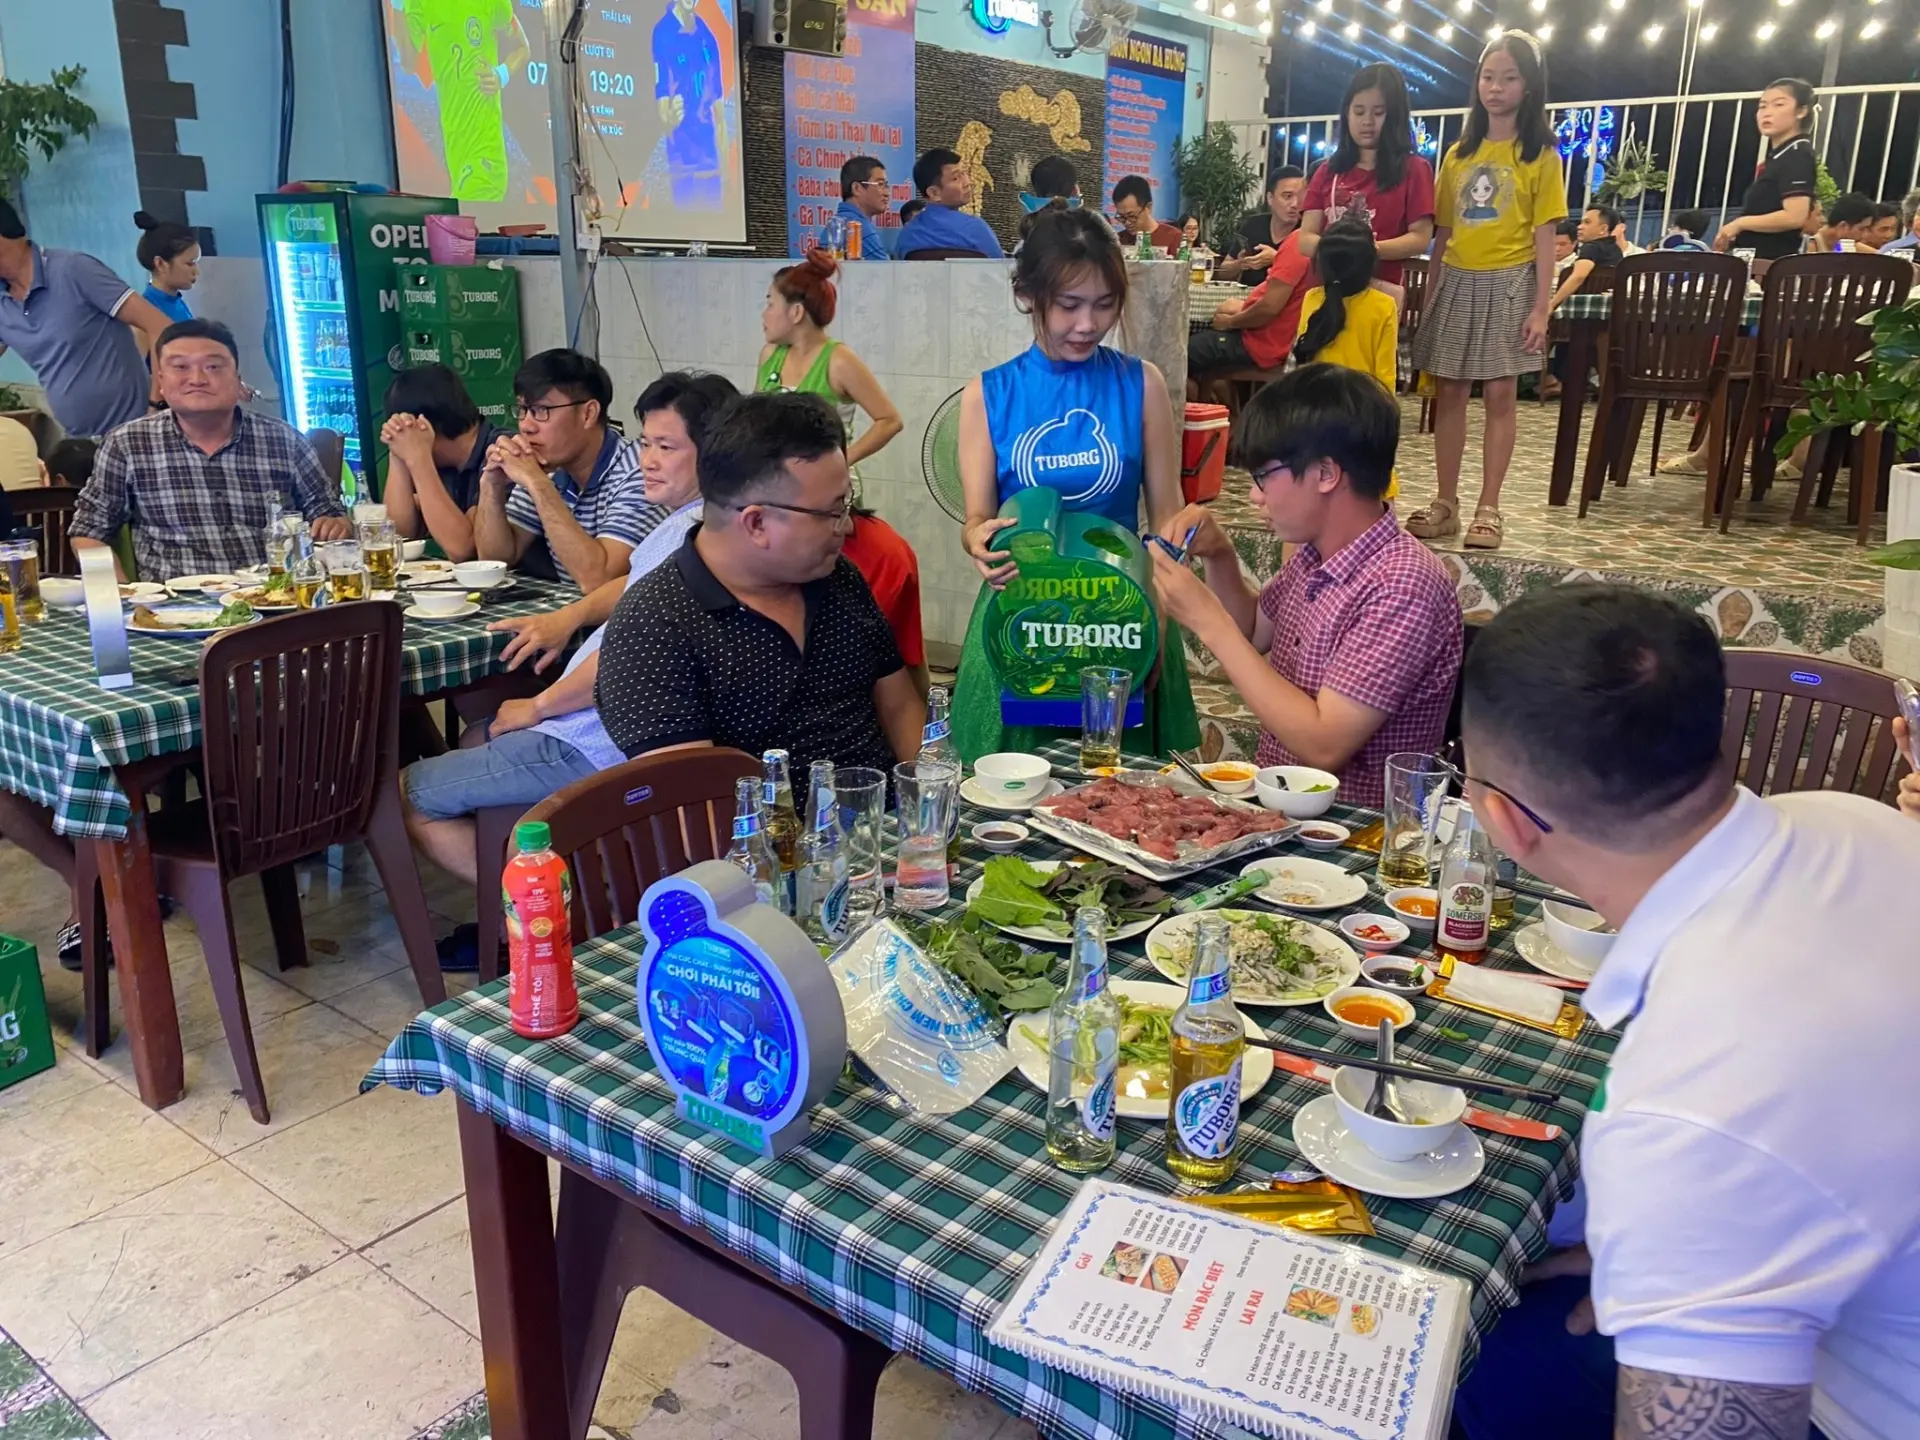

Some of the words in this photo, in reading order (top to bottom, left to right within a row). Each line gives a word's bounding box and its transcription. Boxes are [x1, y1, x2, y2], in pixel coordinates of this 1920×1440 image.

[527, 61, 548, 85] 07
[590, 70, 634, 96] 19:20
[370, 224, 429, 249] OPE
[404, 289, 437, 305] TUBORG
[462, 291, 499, 303] TUBORG
[409, 348, 440, 362] TUBORG
[1035, 449, 1100, 472] TUBORG
[1022, 621, 1141, 649] TUBORG
[667, 964, 698, 982] CHƠI
[1208, 976, 1230, 995] ICE
[1188, 1080, 1240, 1151] TUBORG
[1182, 1304, 1204, 1331] MÓN
[1195, 1281, 1215, 1304] ĐẶC
[1206, 1260, 1226, 1283] BIỆT
[1245, 1289, 1264, 1307] RAI
[1238, 1308, 1256, 1325] LAI
